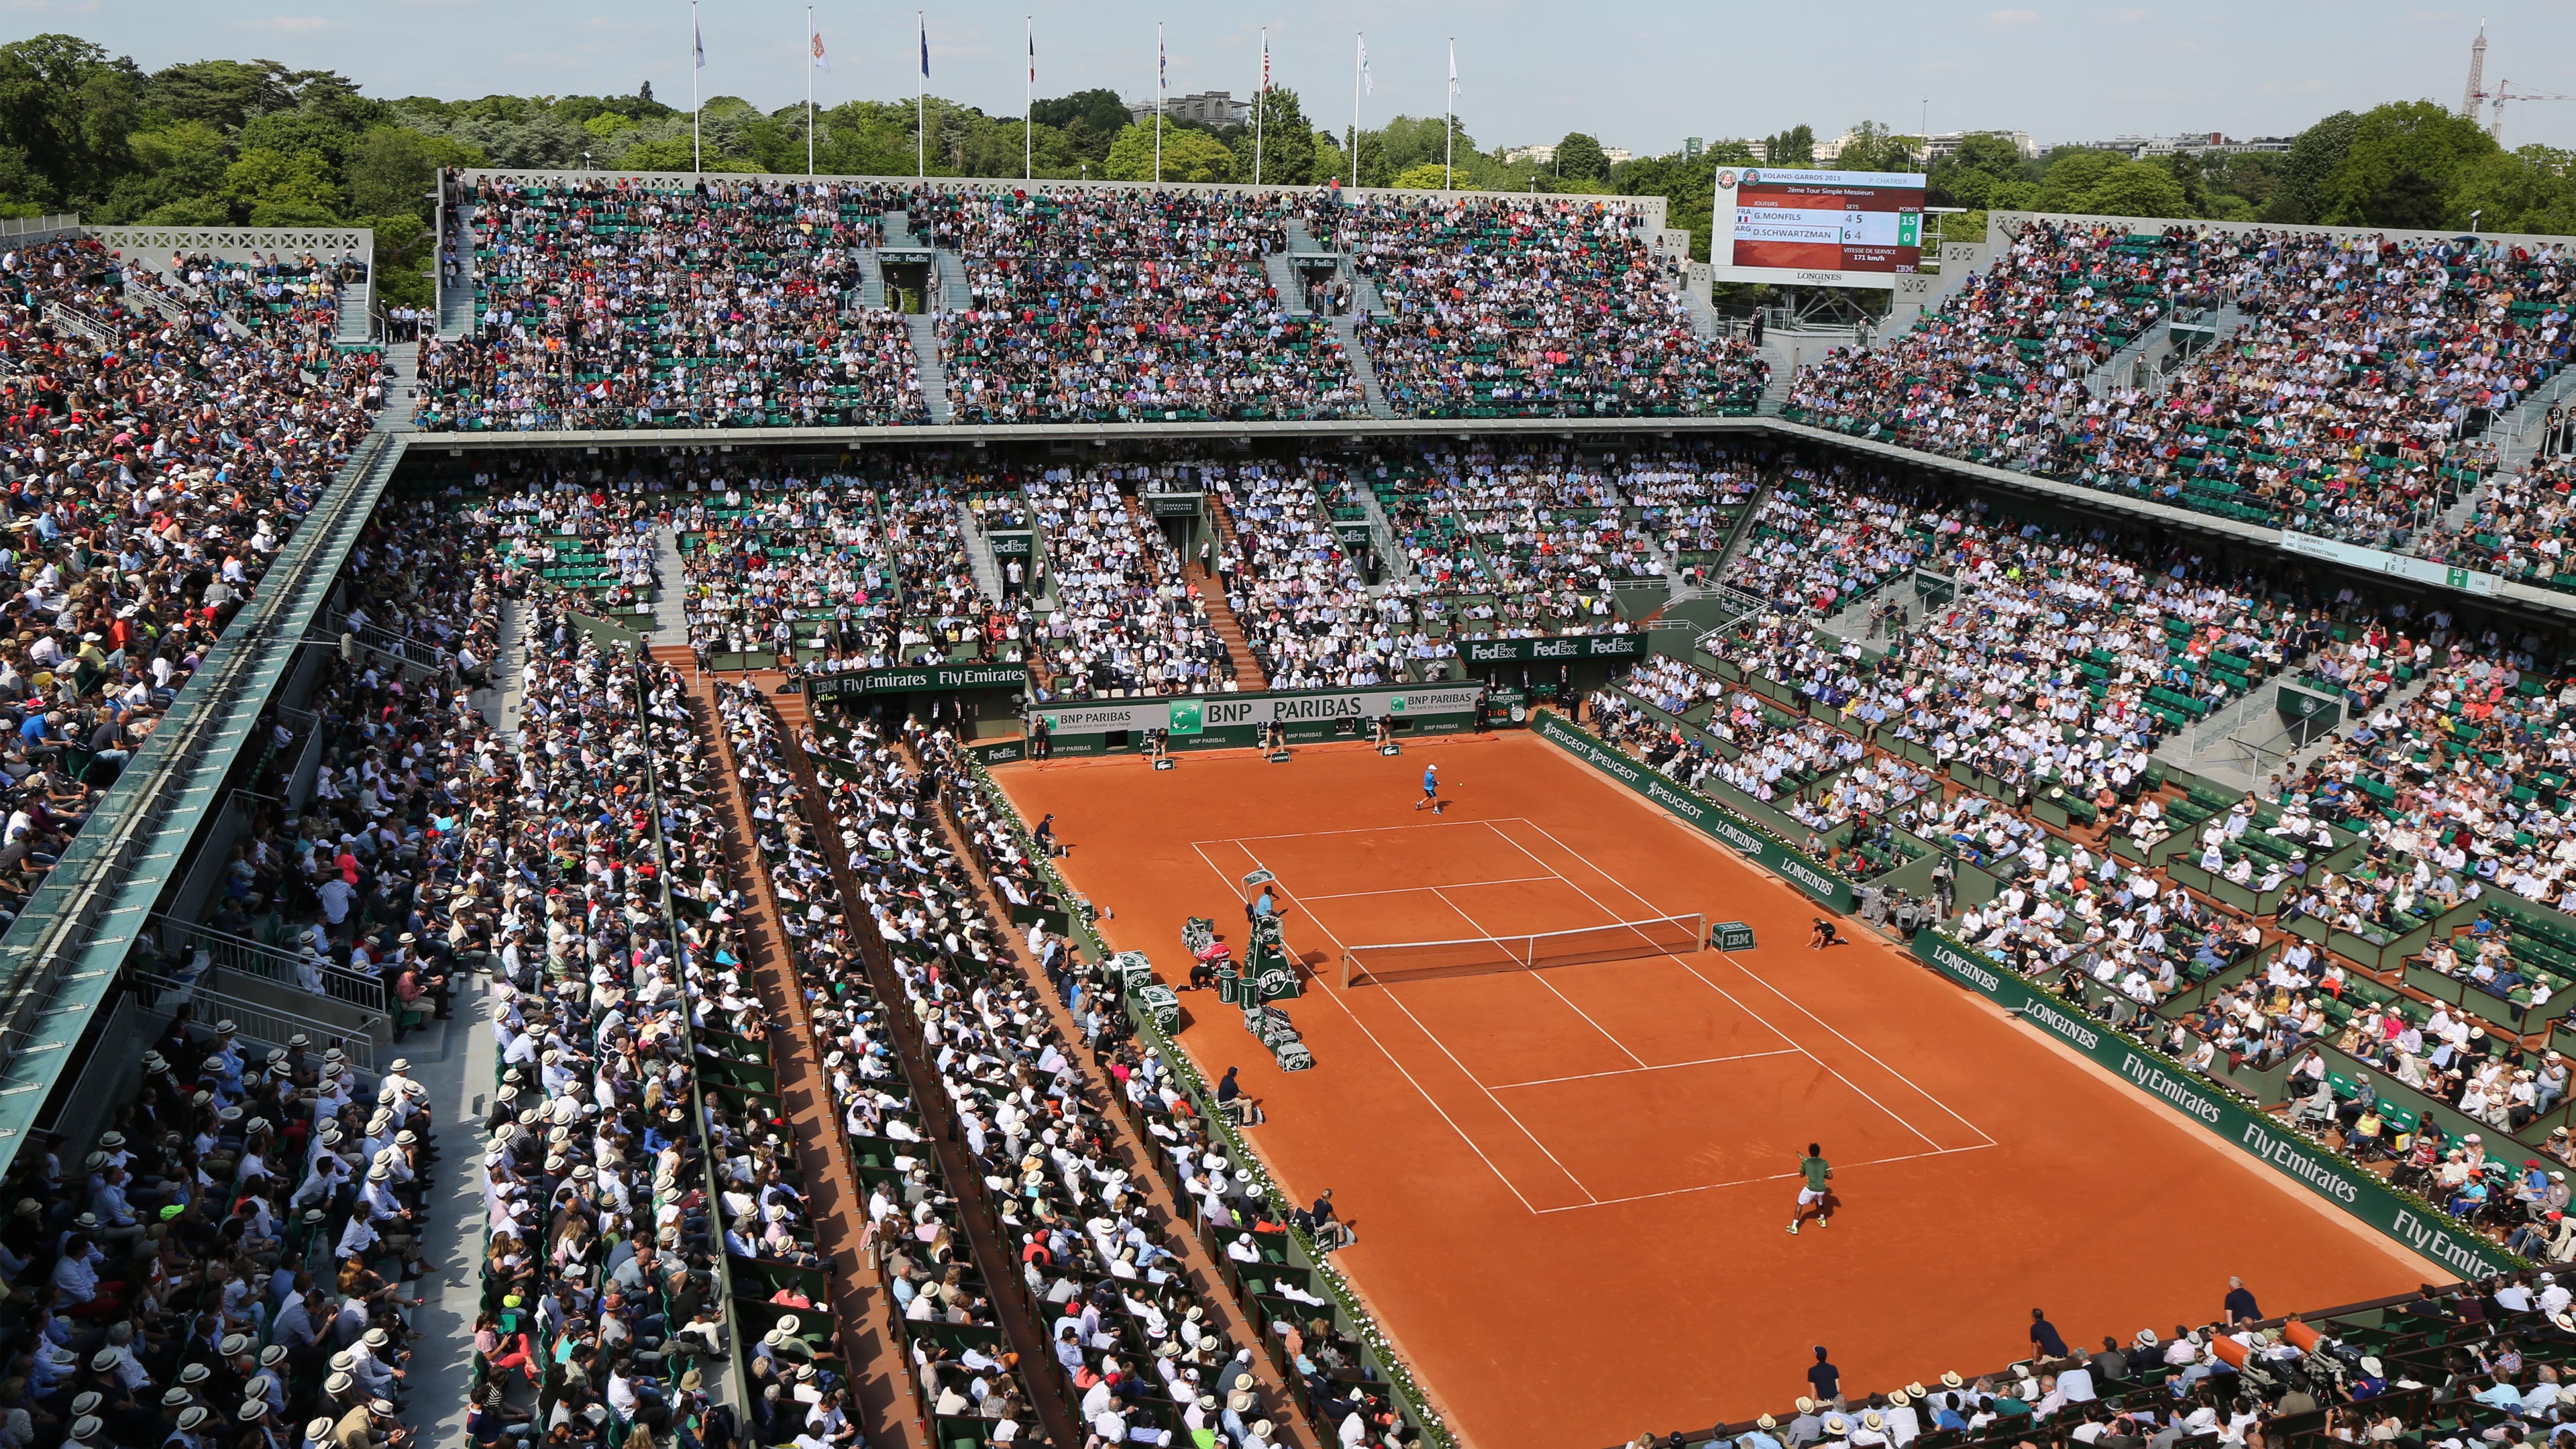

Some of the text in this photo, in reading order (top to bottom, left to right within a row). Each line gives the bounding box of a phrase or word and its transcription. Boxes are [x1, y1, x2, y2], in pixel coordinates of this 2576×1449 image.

[1763, 173, 1823, 181] ROLAND-GARROS
[1821, 187, 1843, 196] Simple
[1844, 189, 1874, 197] Messieurs
[1754, 213, 1801, 221] G.MONFILS
[1845, 214, 1862, 223] 4 5
[1900, 216, 1916, 225] 15
[1753, 229, 1831, 239] D.SCHWARTZMAN
[1844, 231, 1861, 239] 6 4
[1903, 232, 1911, 242] 0
[906, 254, 928, 262] FedEx
[1315, 259, 1334, 267] FedEx
[1895, 264, 1915, 273] IBM
[1797, 272, 1841, 281] LONGINES
[2300, 536, 2324, 546] G.MONFILS
[2298, 544, 2339, 558] D.SCHWARTZMAN
[2453, 569, 2462, 578] 15
[1721, 597, 1742, 616] FedEx
[1471, 637, 1634, 660] FedEx FedEx FedEx
[843, 667, 1025, 694] Fly Emirates Fly Emirates
[815, 679, 838, 694] IBM
[1408, 693, 1471, 705] BNP PARIBAS
[1208, 696, 1362, 722] BNP PARIBAS
[1061, 711, 1131, 724] BNP PARIBAS
[988, 748, 1017, 761] FedEx
[1549, 725, 1704, 820] PEUGEOT PEUGEOT PEUGEOT
[1715, 820, 1835, 896] LONGINES LONGINES
[1727, 932, 1750, 946] IBM
[1932, 945, 2099, 1051] LONGINES LONGINES
[2122, 1052, 2151, 1085] Fly
[2148, 1067, 2220, 1124] Emirates
[2243, 1122, 2276, 1159] Fly
[2272, 1140, 2358, 1203] Emirates
[2393, 1208, 2432, 1249] Fly
